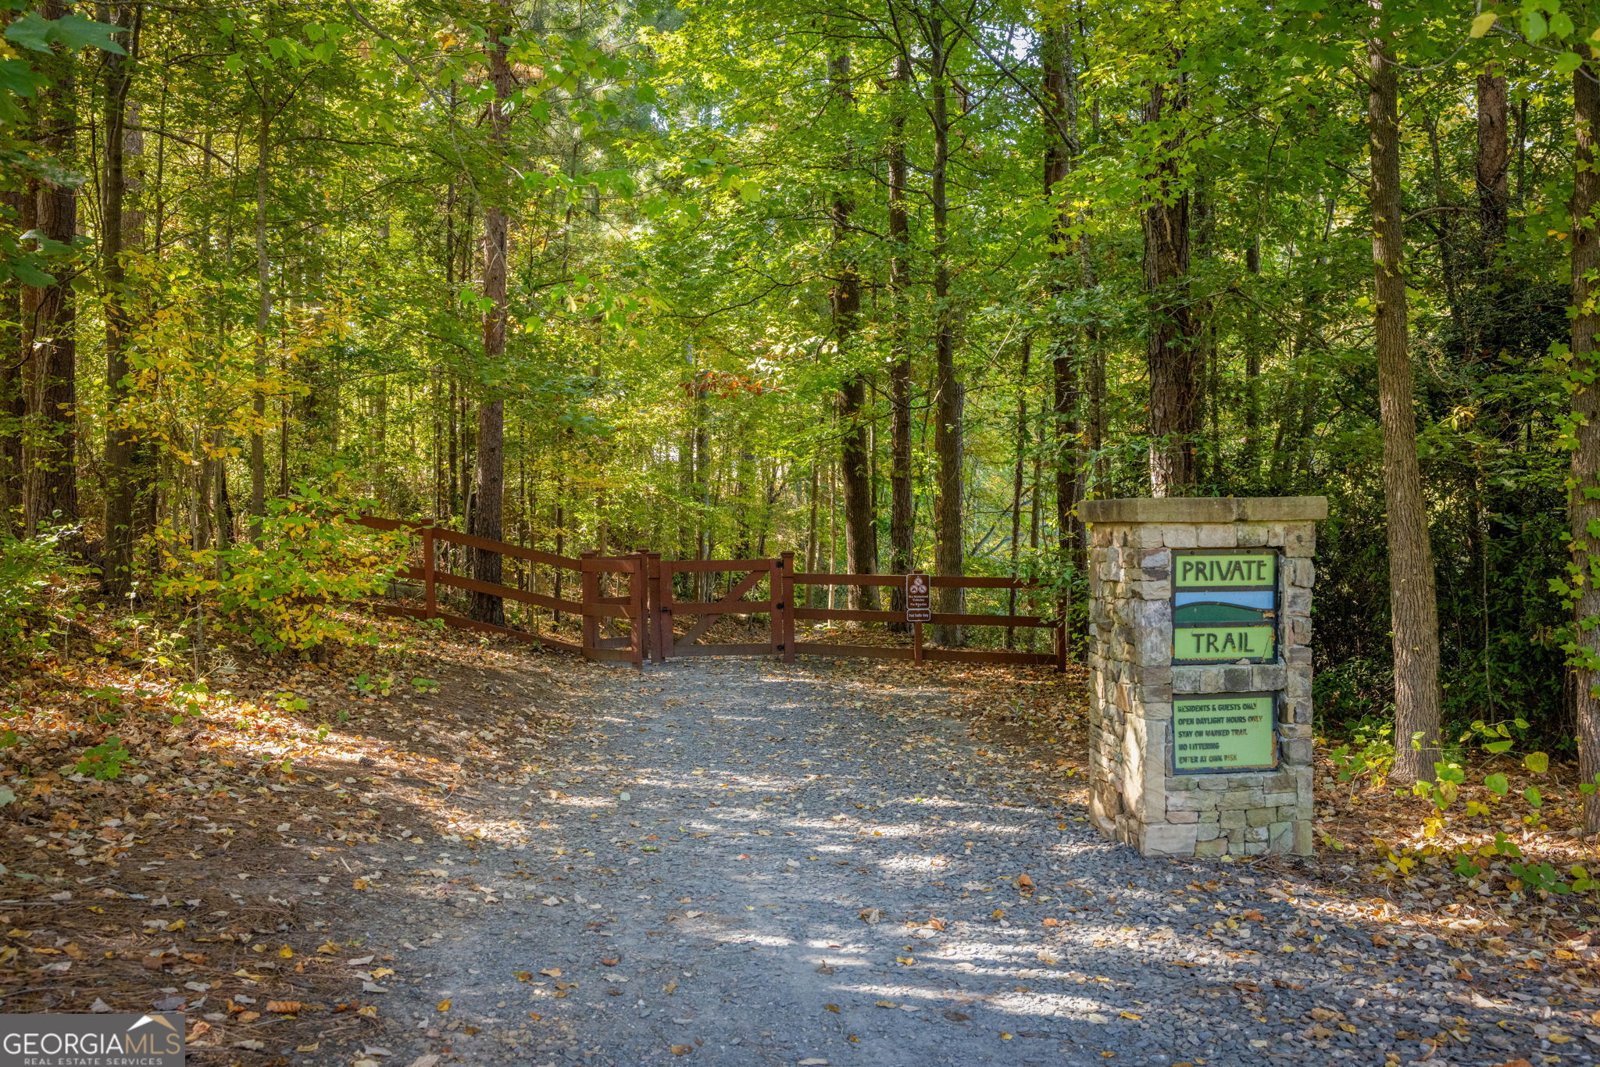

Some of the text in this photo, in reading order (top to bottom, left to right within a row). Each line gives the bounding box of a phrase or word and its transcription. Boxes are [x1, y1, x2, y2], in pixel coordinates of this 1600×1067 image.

[1182, 560, 1267, 581] PRIVATE
[1191, 632, 1254, 653] TRAIL
[1218, 703, 1241, 711] GUESTS
[1178, 717, 1194, 725] OPEN
[1196, 716, 1224, 725] DAYLIGHT
[1226, 716, 1246, 724] HOURS
[1178, 730, 1193, 738] STAY
[1194, 730, 1204, 738] ON
[1205, 729, 1230, 737] MARKED
[1178, 743, 1188, 751] NO
